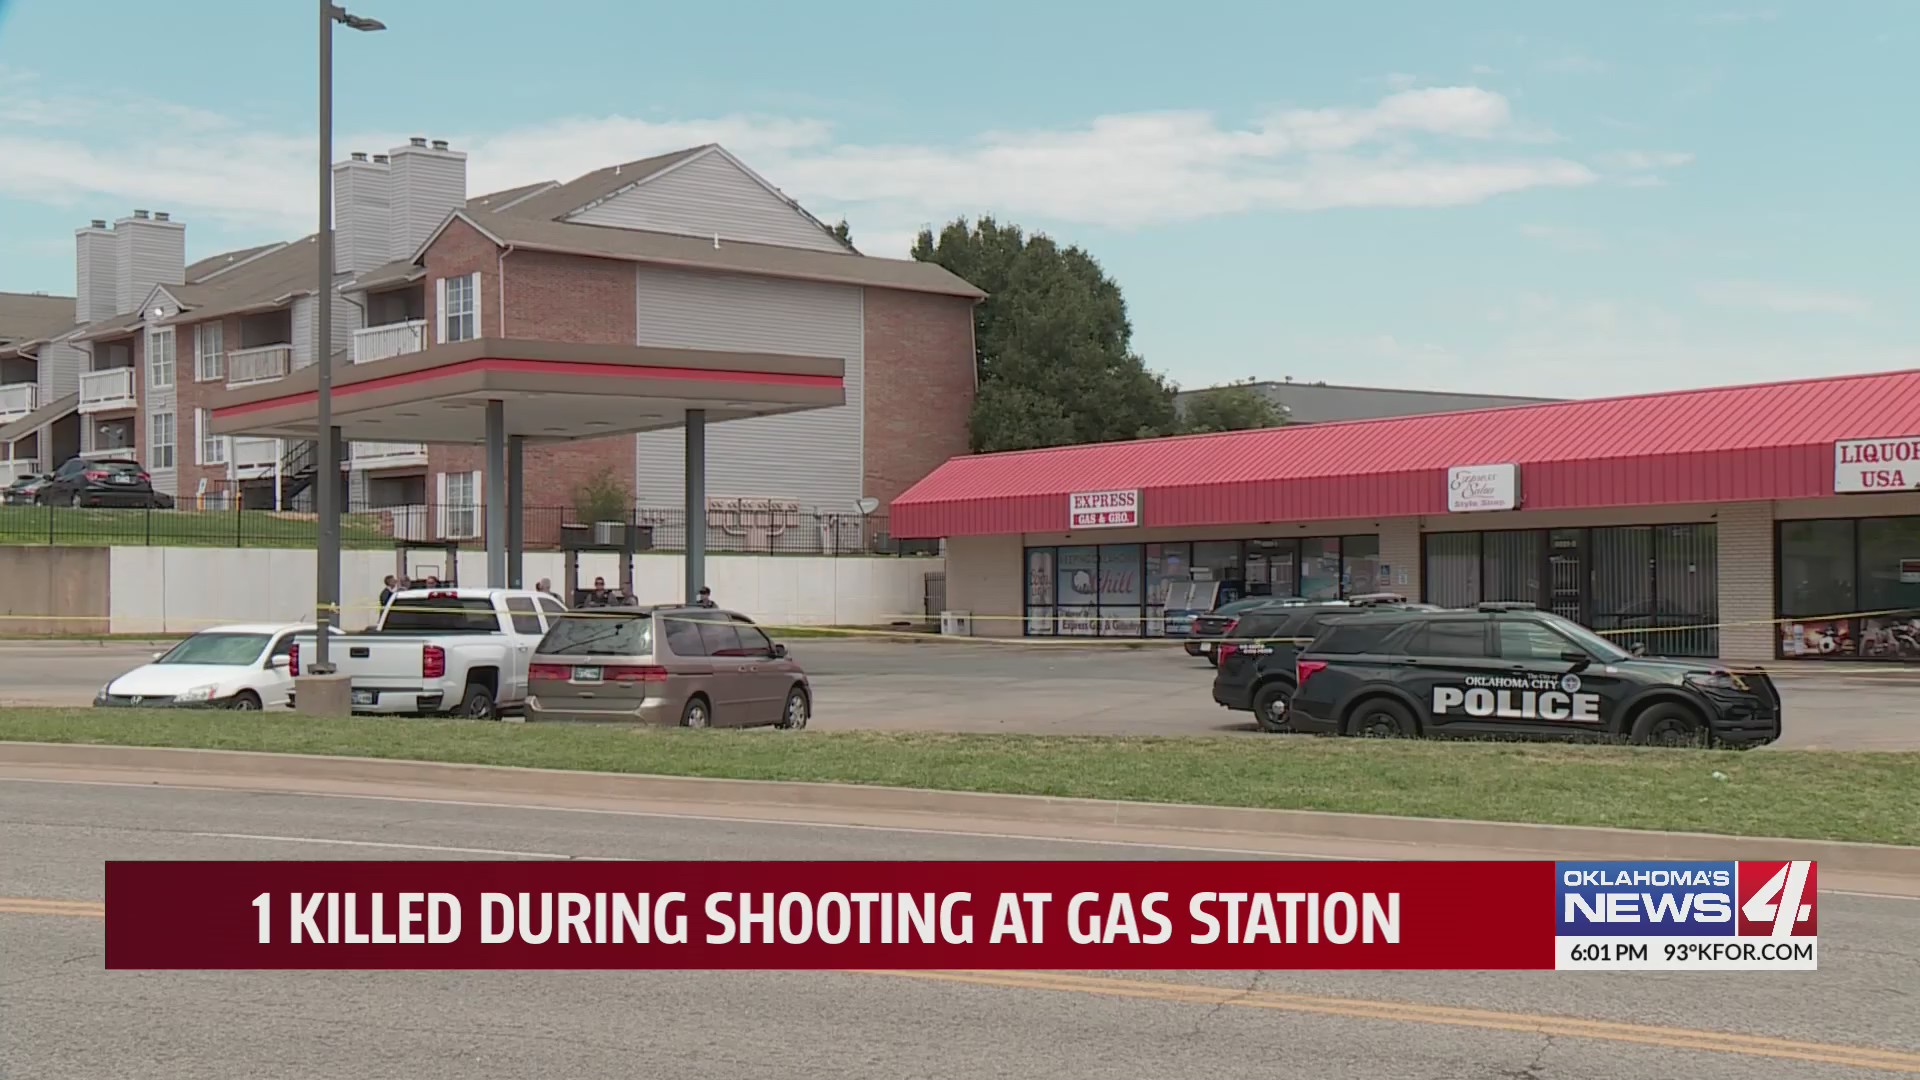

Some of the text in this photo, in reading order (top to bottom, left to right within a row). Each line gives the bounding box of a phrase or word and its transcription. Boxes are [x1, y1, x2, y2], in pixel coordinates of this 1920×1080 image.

[1861, 470, 1906, 487] USA
[1074, 492, 1135, 509] EXPRESS
[1078, 512, 1129, 524] GAS & GRO.
[1465, 676, 1559, 690] OKLAHOMA CITY
[1432, 686, 1601, 722] POLICE
